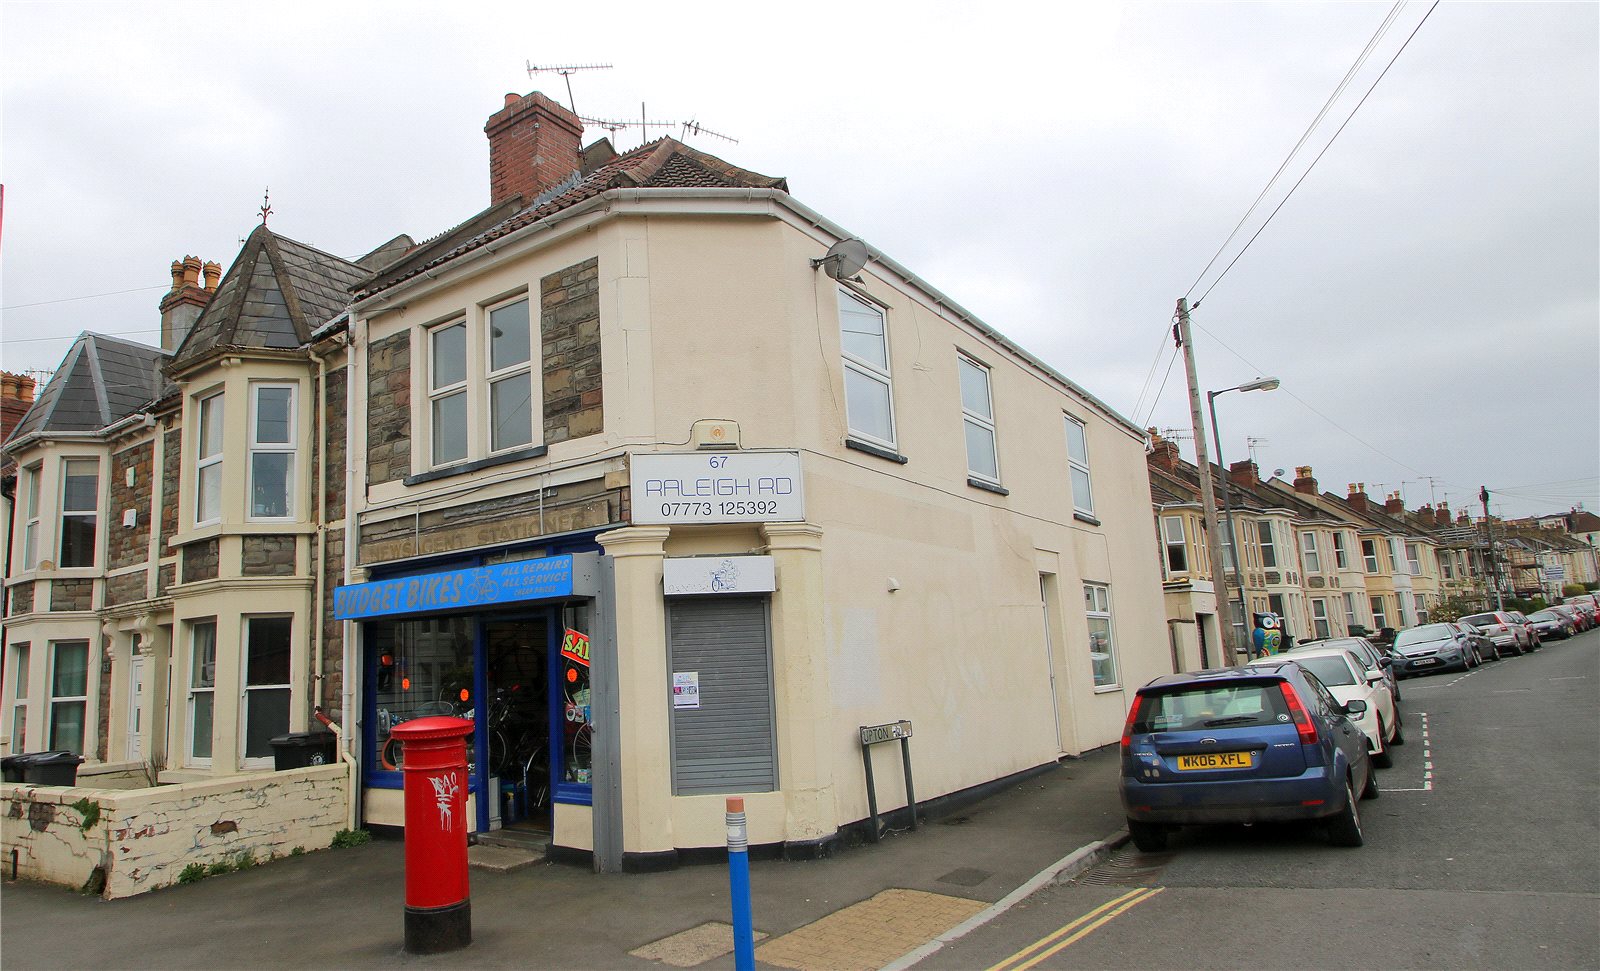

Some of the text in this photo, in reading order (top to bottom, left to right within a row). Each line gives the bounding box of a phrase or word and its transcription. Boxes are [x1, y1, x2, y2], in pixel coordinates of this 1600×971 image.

[709, 456, 728, 468] 67
[646, 477, 792, 497] RALEIGH RD
[661, 501, 777, 516] 07773 125392
[502, 559, 570, 577] ALL REPAIRS
[503, 571, 568, 588] ALL SERVICE
[336, 574, 464, 616] BUDGET BIKES
[863, 727, 889, 742] UPTON
[1182, 753, 1246, 767] WK06 XFL
